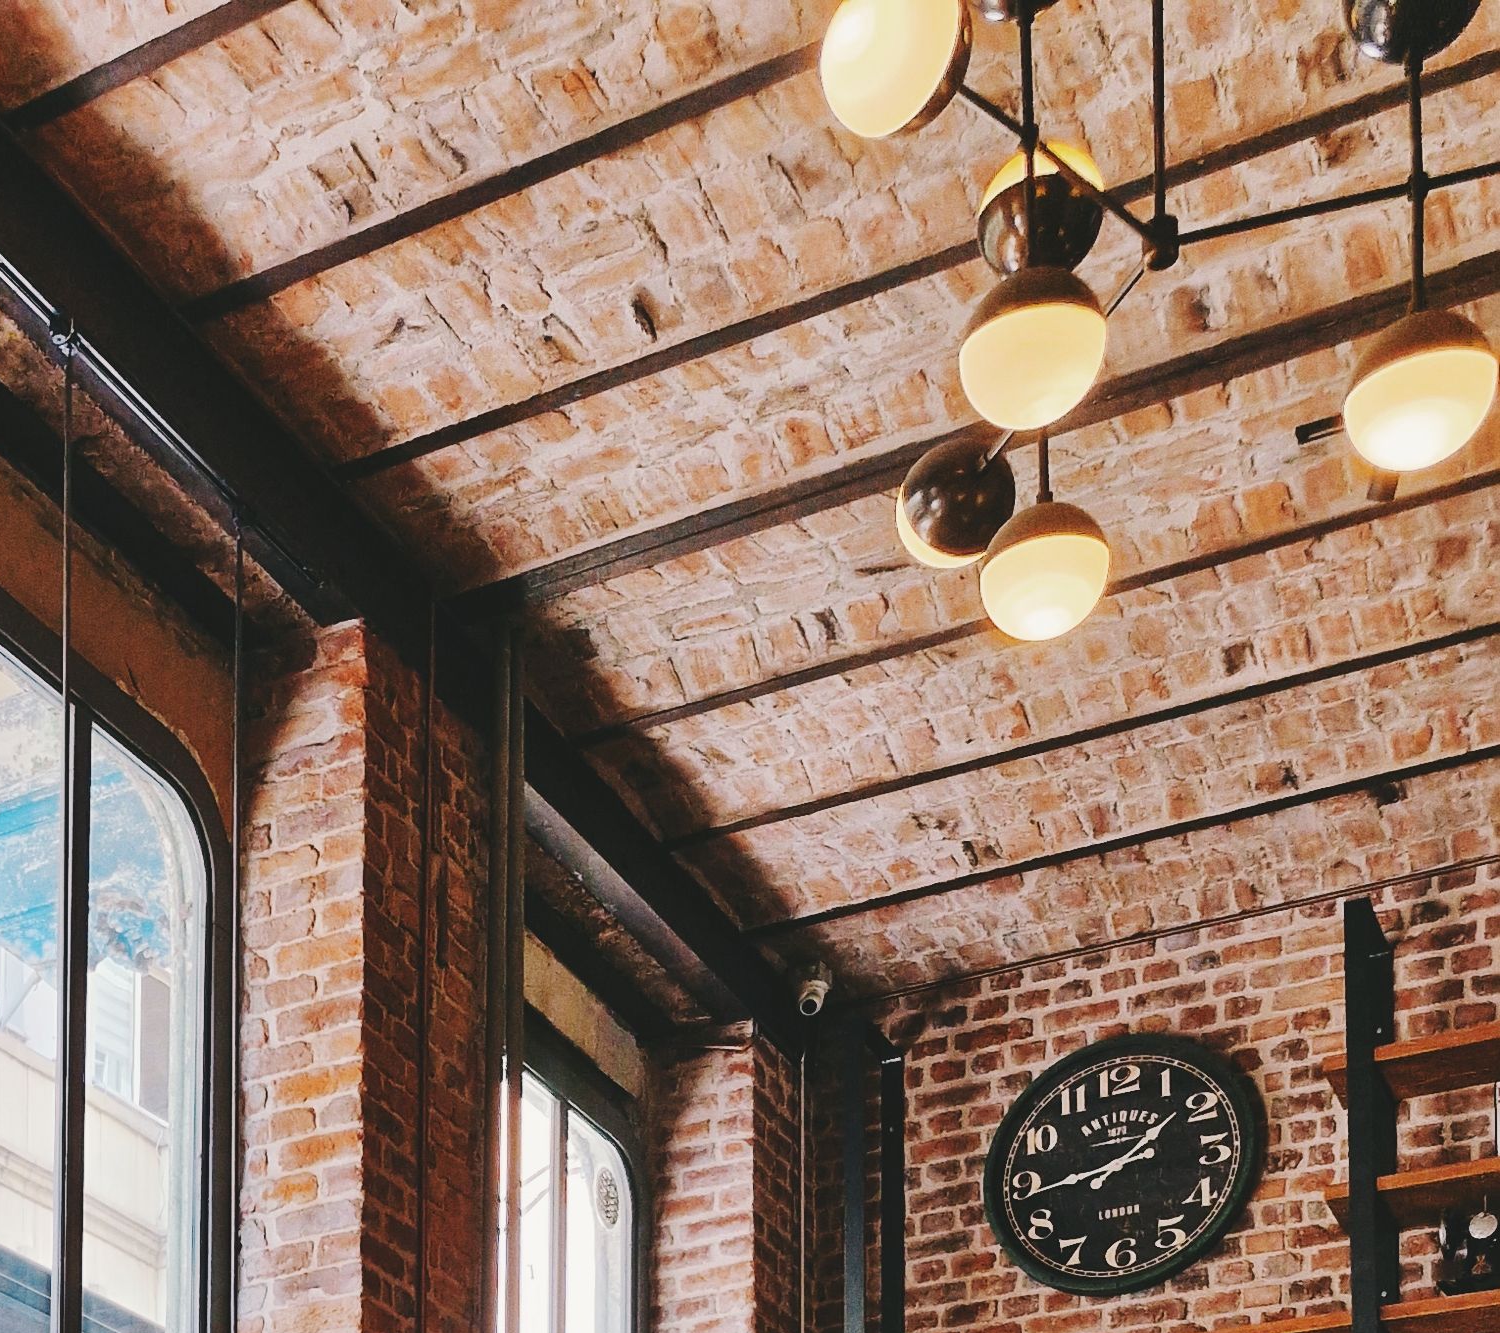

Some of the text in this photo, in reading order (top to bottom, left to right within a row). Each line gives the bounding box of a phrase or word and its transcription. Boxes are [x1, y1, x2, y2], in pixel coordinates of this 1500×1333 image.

[1098, 1065, 1141, 1098] 12
[1160, 1068, 1171, 1097] 1
[1061, 1084, 1086, 1115] 11
[1185, 1091, 1218, 1122] 2
[1081, 1109, 1159, 1137] ANTIQUES
[1026, 1124, 1058, 1155] 10
[1199, 1132, 1232, 1165] 3
[1012, 1171, 1042, 1200] 9
[1181, 1177, 1218, 1207] 4
[1027, 1209, 1054, 1240] 8
[1098, 1204, 1140, 1220] LONDON
[1155, 1214, 1186, 1249] 5
[1059, 1235, 1088, 1266] 7
[1105, 1238, 1137, 1268] 6
